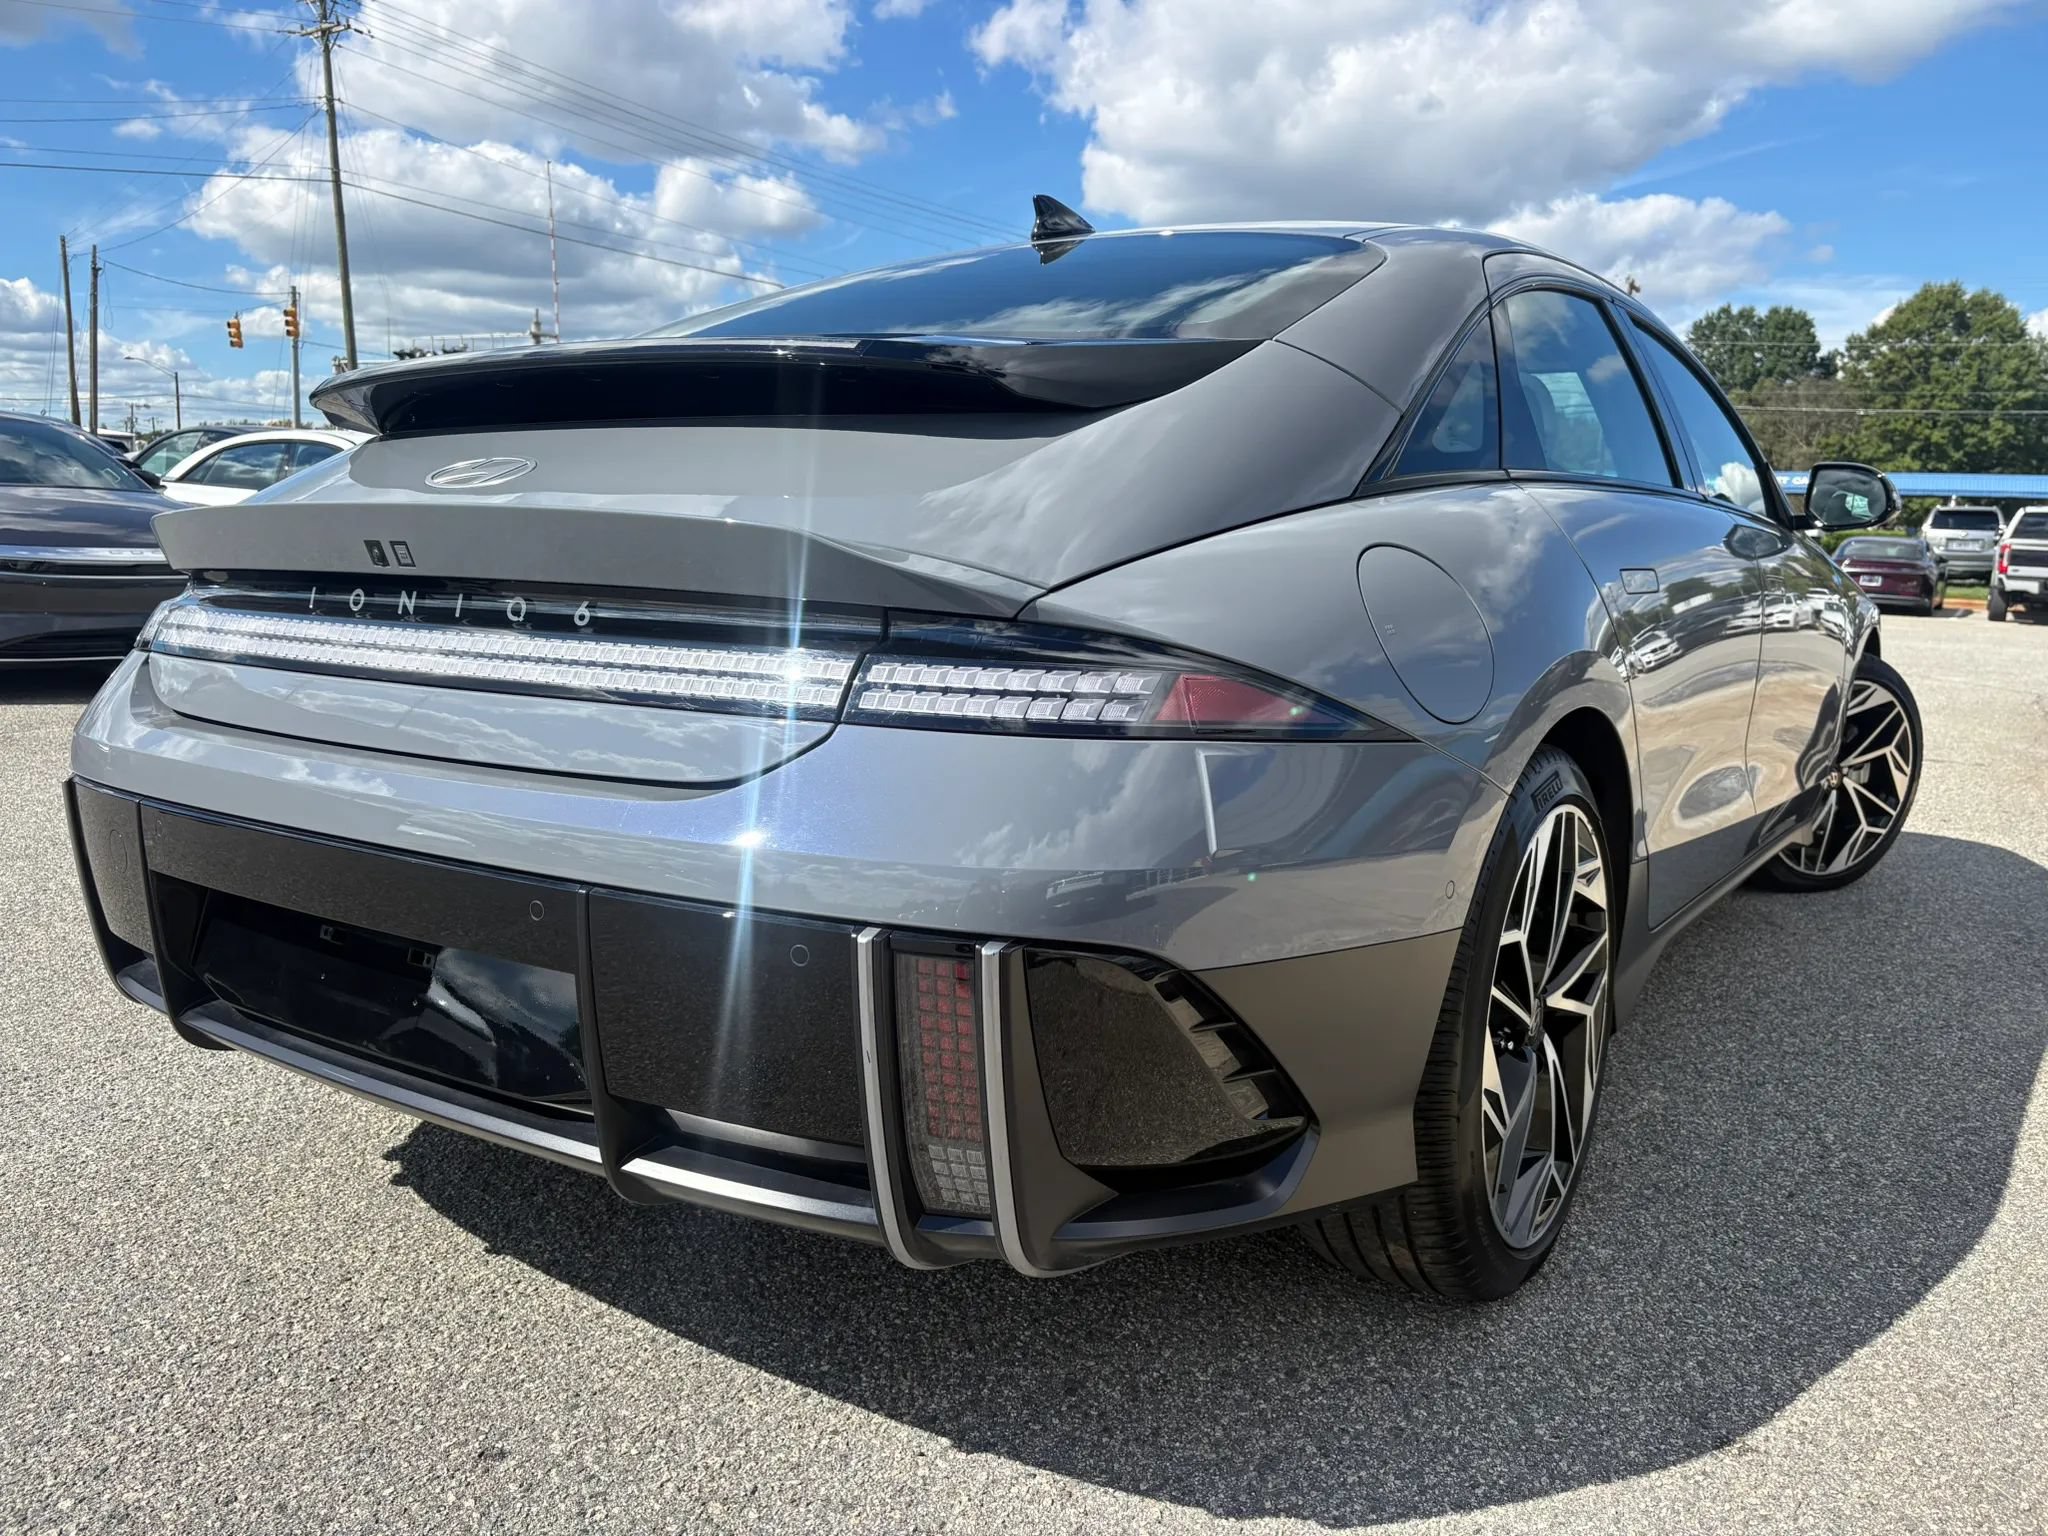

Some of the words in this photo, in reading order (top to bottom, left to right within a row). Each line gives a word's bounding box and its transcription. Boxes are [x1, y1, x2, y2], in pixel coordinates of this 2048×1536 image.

[309, 586, 527, 622] IONIQ
[573, 600, 591, 626] 6
[1530, 770, 1564, 813] PIRELLI
